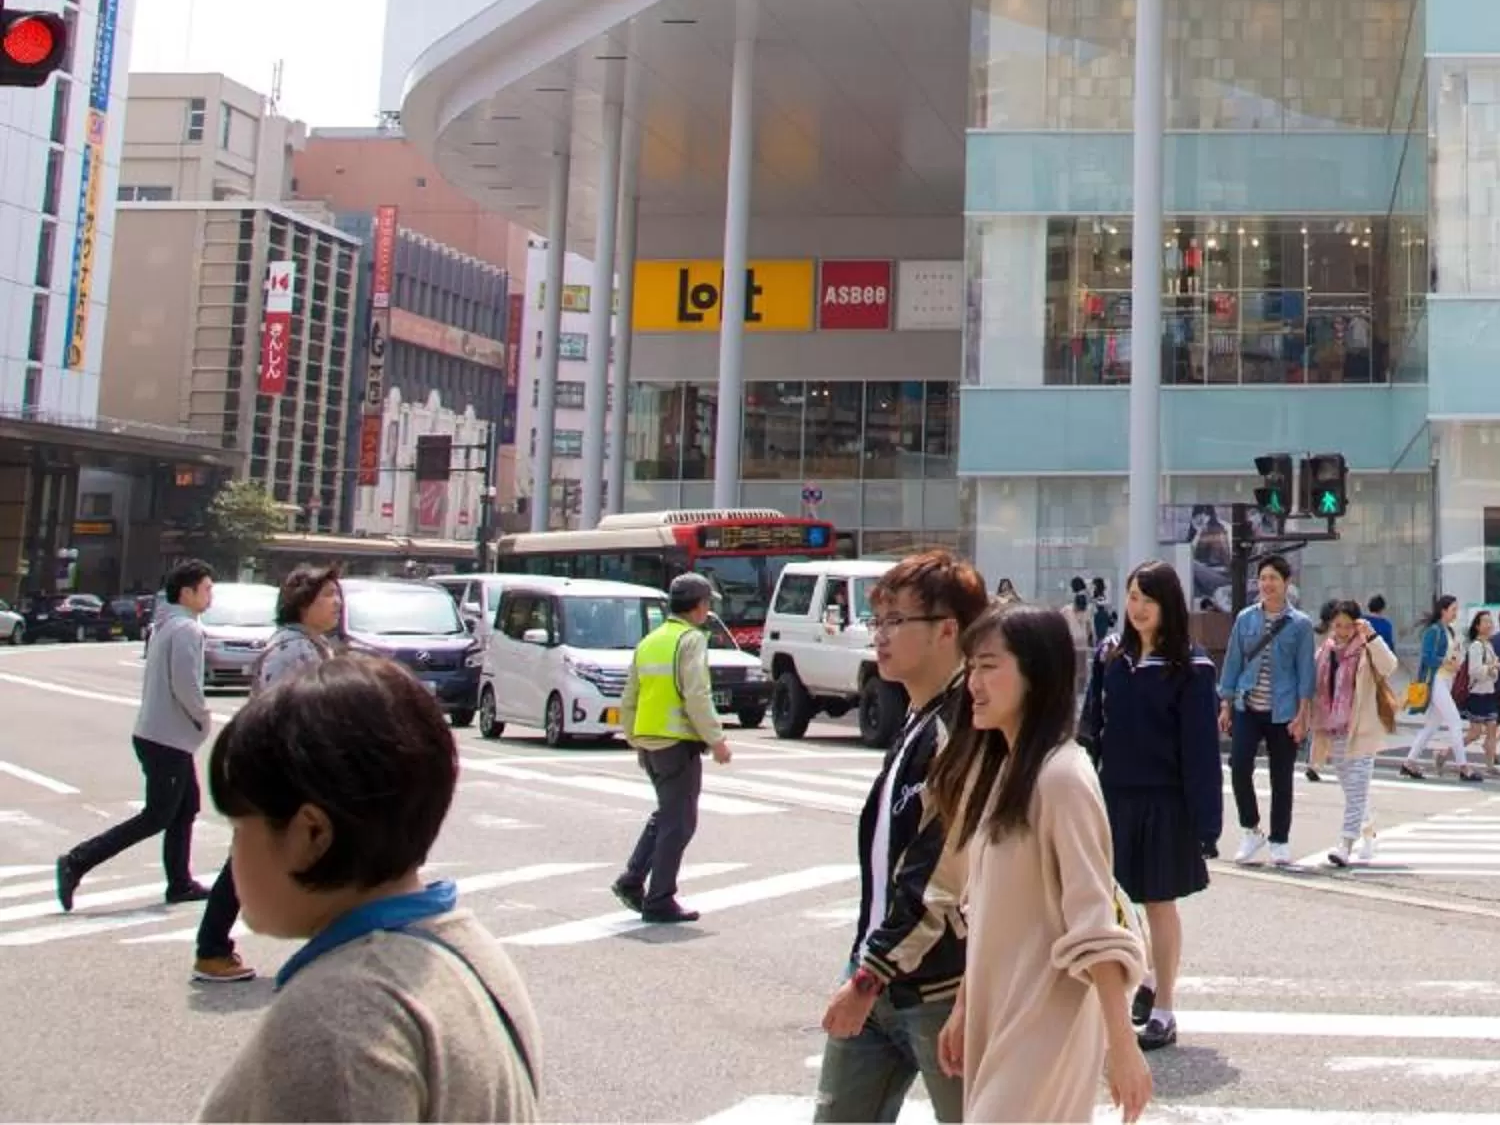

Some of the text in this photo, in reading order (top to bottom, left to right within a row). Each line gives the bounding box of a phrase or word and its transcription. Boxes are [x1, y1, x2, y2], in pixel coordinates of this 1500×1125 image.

[678, 268, 763, 322] Lot
[265, 322, 284, 379] きんしん
